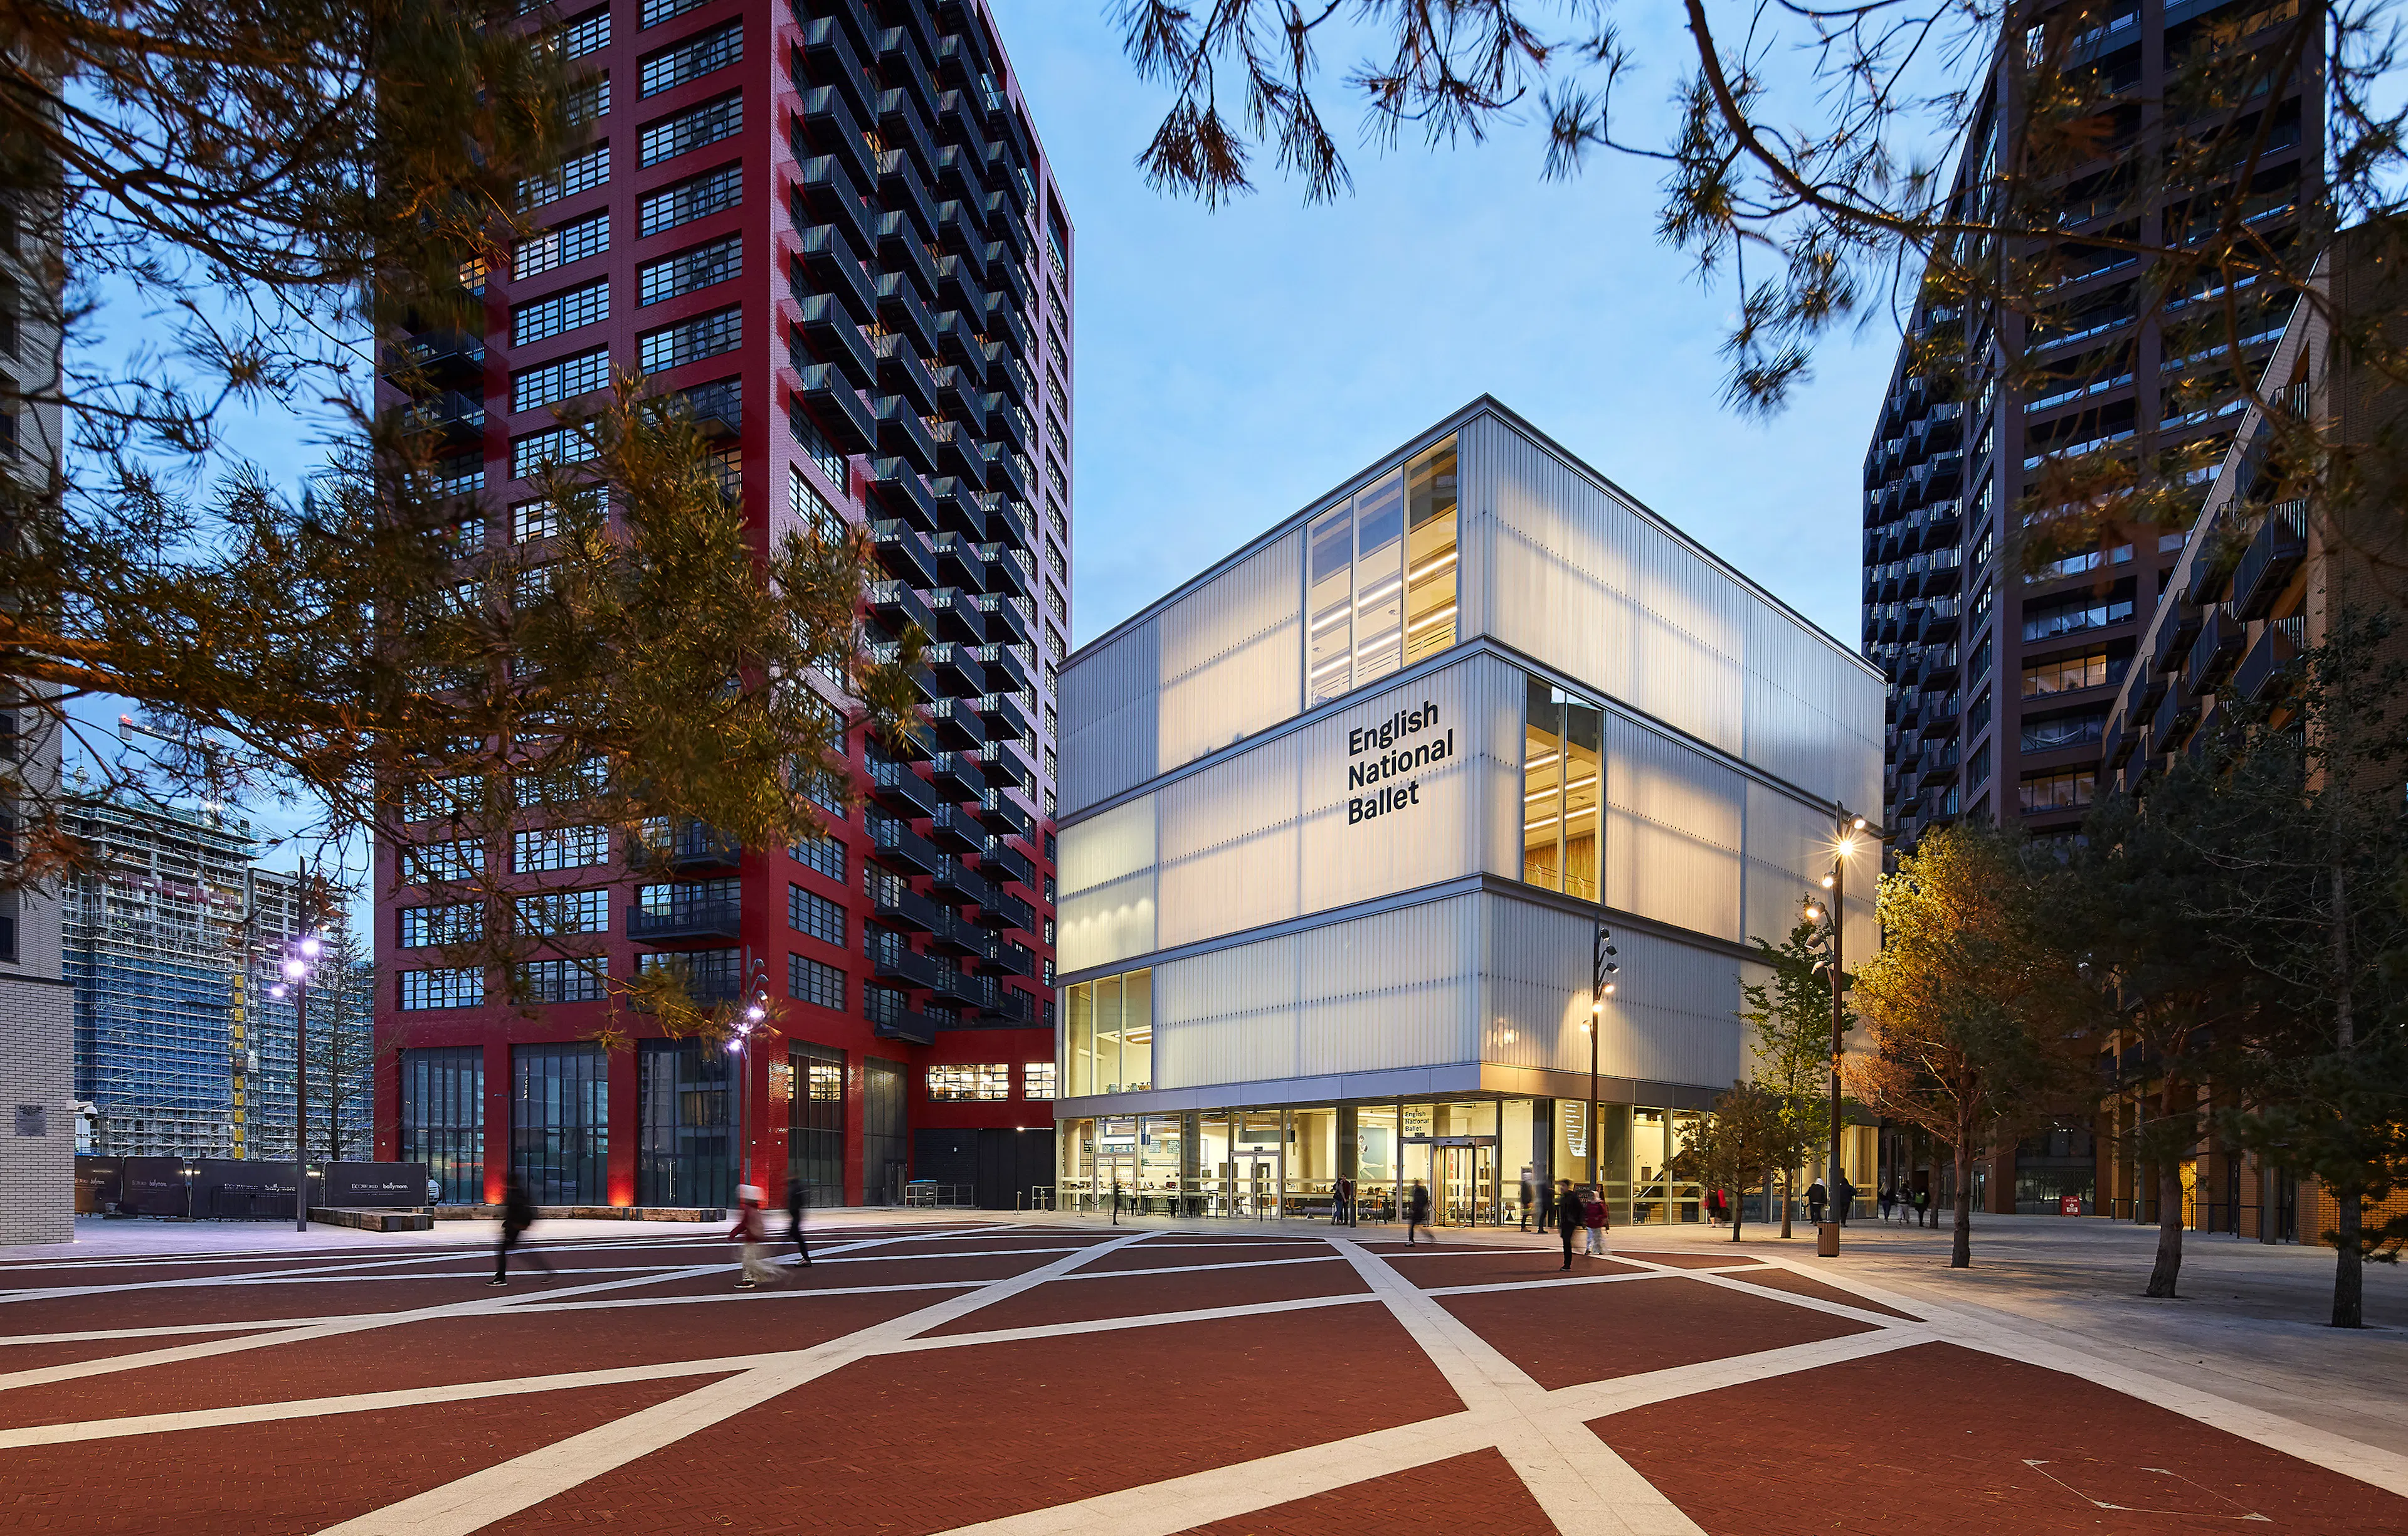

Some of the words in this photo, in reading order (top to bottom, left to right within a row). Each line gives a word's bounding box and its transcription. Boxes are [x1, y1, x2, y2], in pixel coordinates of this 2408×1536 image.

[1349, 701, 1438, 756] English
[1349, 728, 1453, 790] National
[1349, 780, 1419, 825] Ballet
